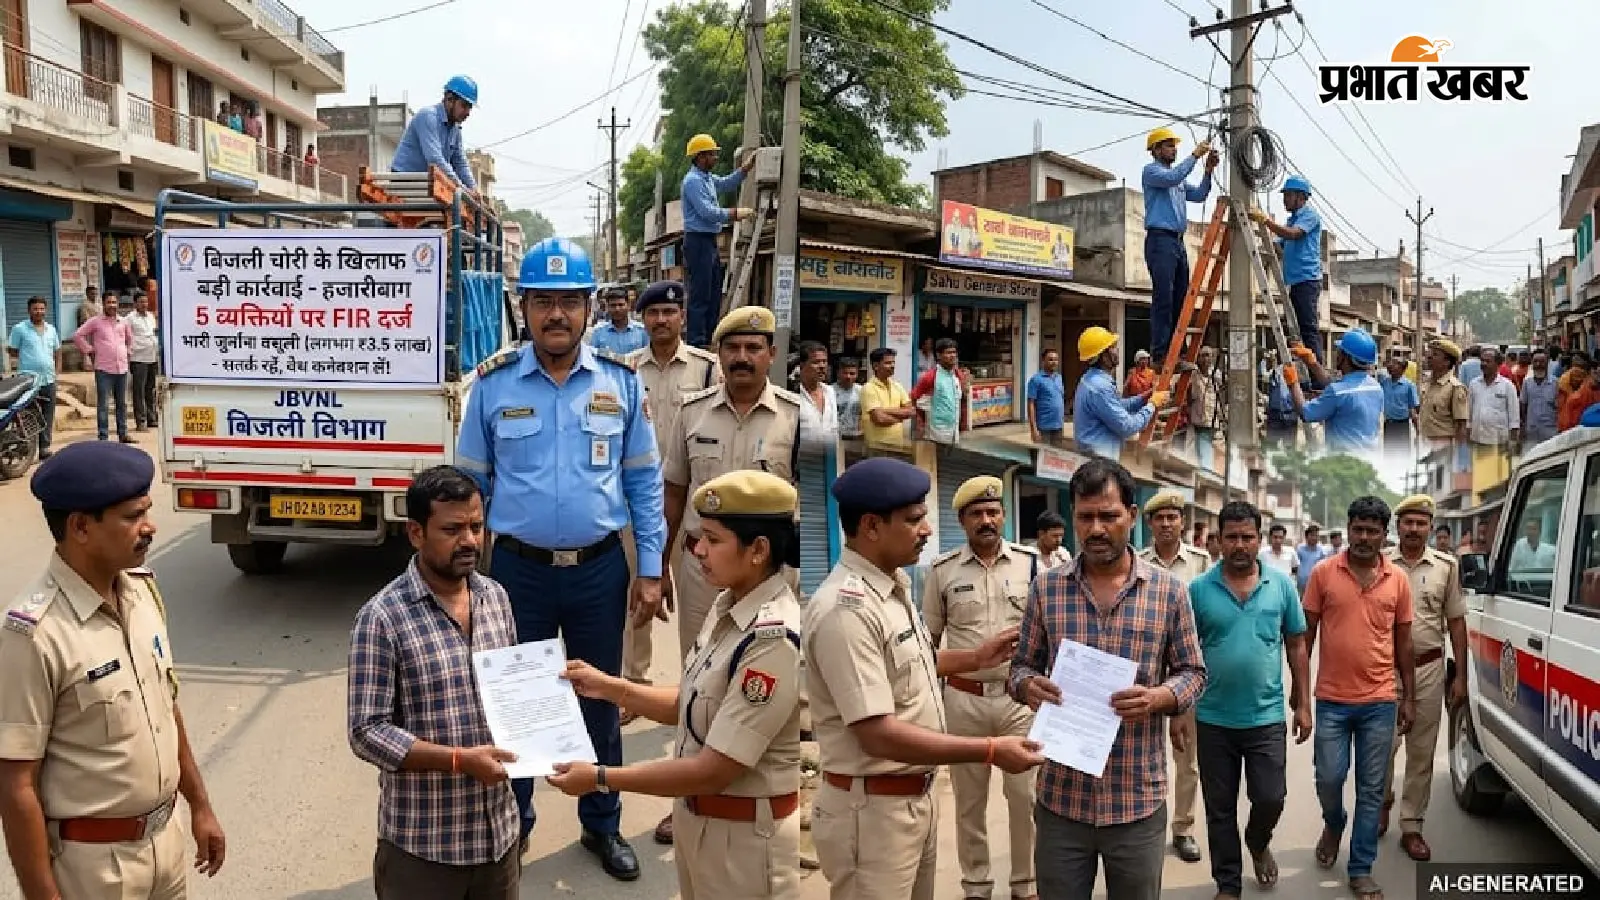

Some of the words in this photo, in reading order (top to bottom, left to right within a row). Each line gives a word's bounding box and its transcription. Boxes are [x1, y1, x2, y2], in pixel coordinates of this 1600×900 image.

[203, 246, 264, 269] बिजली
[269, 246, 308, 269] चोरी
[314, 246, 332, 269] के
[337, 246, 406, 269] खिलाफ
[197, 274, 231, 301] बड़ी
[236, 274, 303, 300] कार्रवाई
[323, 275, 412, 301] हजारीबाग
[930, 271, 960, 289] Sahu
[964, 275, 1007, 295] General
[1010, 281, 1038, 297] Store
[196, 305, 209, 326] 5
[216, 302, 294, 328] व्यक्तियों
[300, 309, 325, 328] पर
[333, 308, 370, 328] FIR
[377, 303, 413, 330] दर्ज
[181, 332, 211, 348] भारी
[274, 390, 343, 408] JBVNL
[227, 409, 305, 438] बिजली
[312, 412, 387, 440] विभाग
